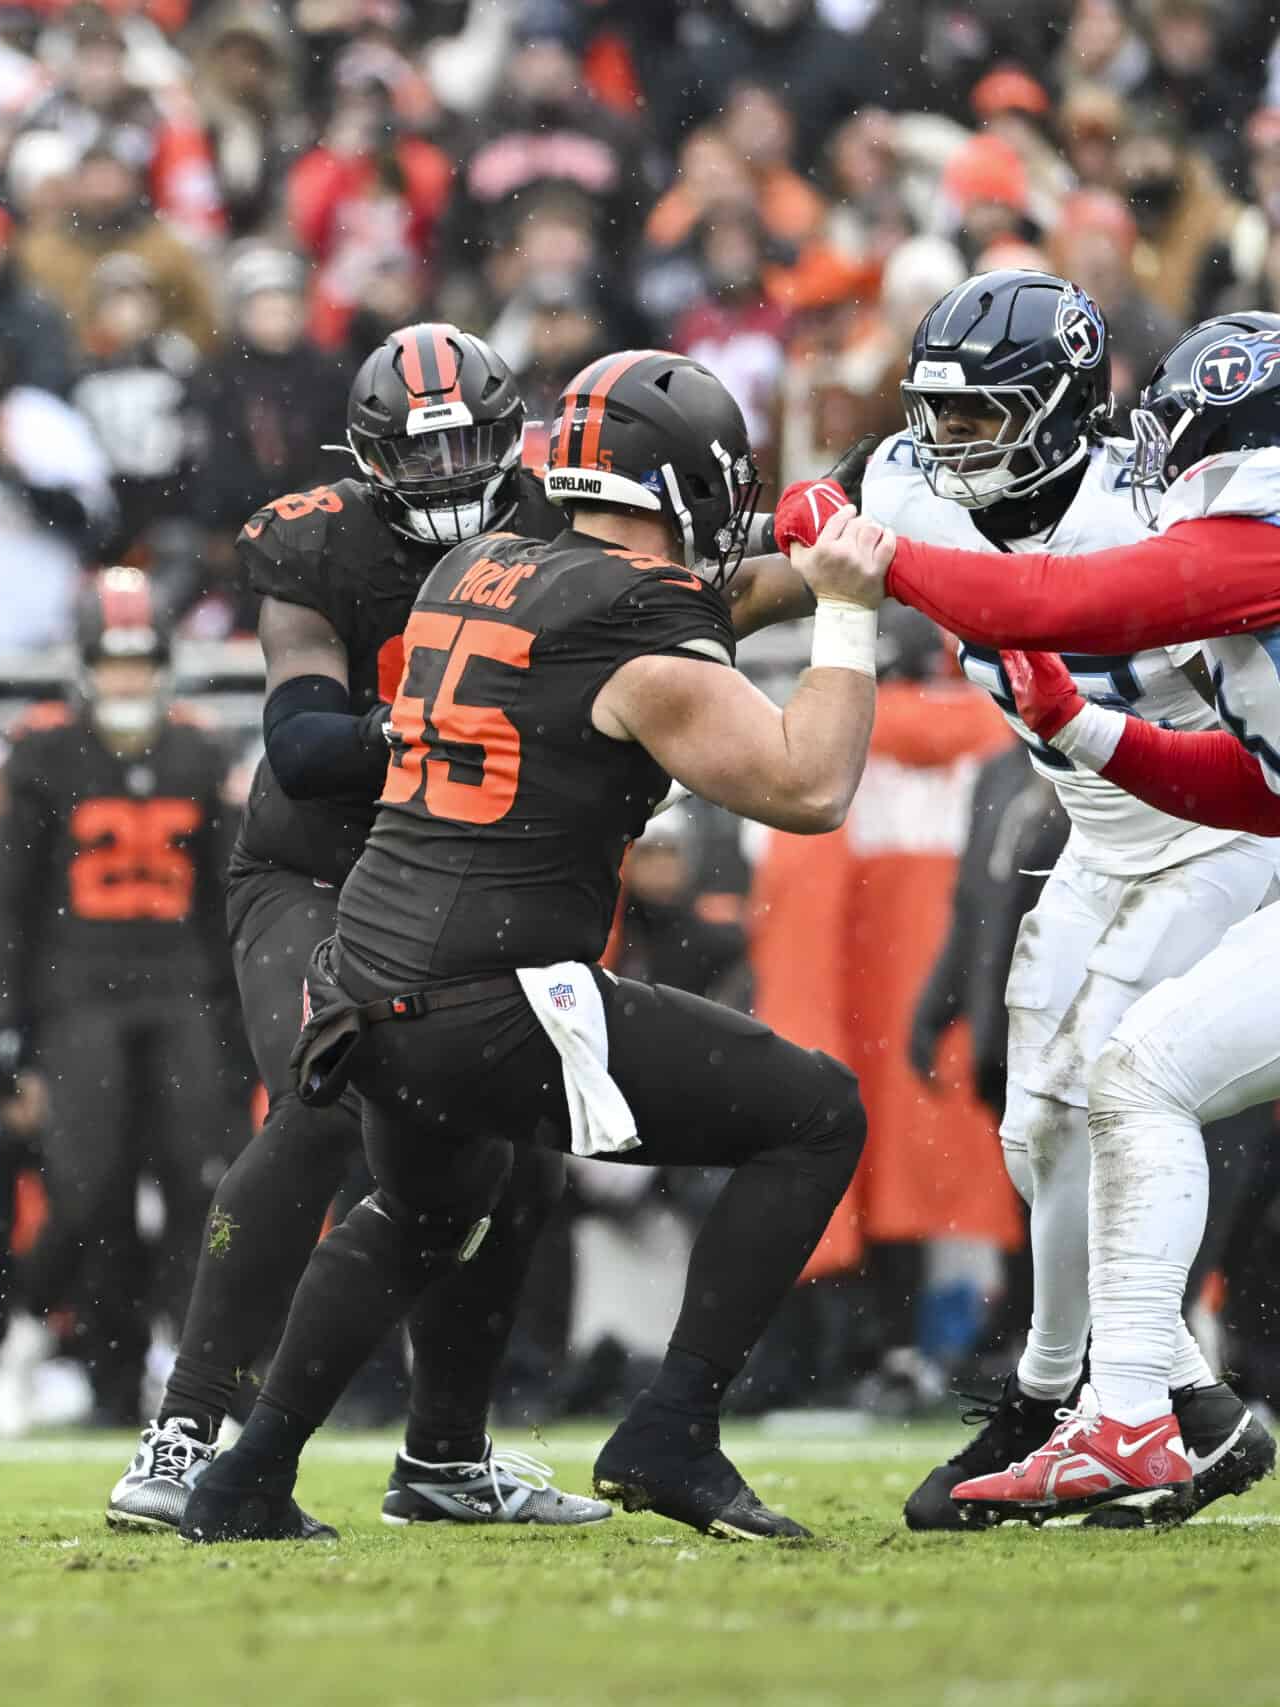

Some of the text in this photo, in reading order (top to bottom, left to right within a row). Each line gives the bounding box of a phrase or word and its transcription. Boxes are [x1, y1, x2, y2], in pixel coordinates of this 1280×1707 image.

[1205, 356, 1246, 392] T
[549, 476, 602, 494] CLEVELAND
[379, 611, 538, 825] 55
